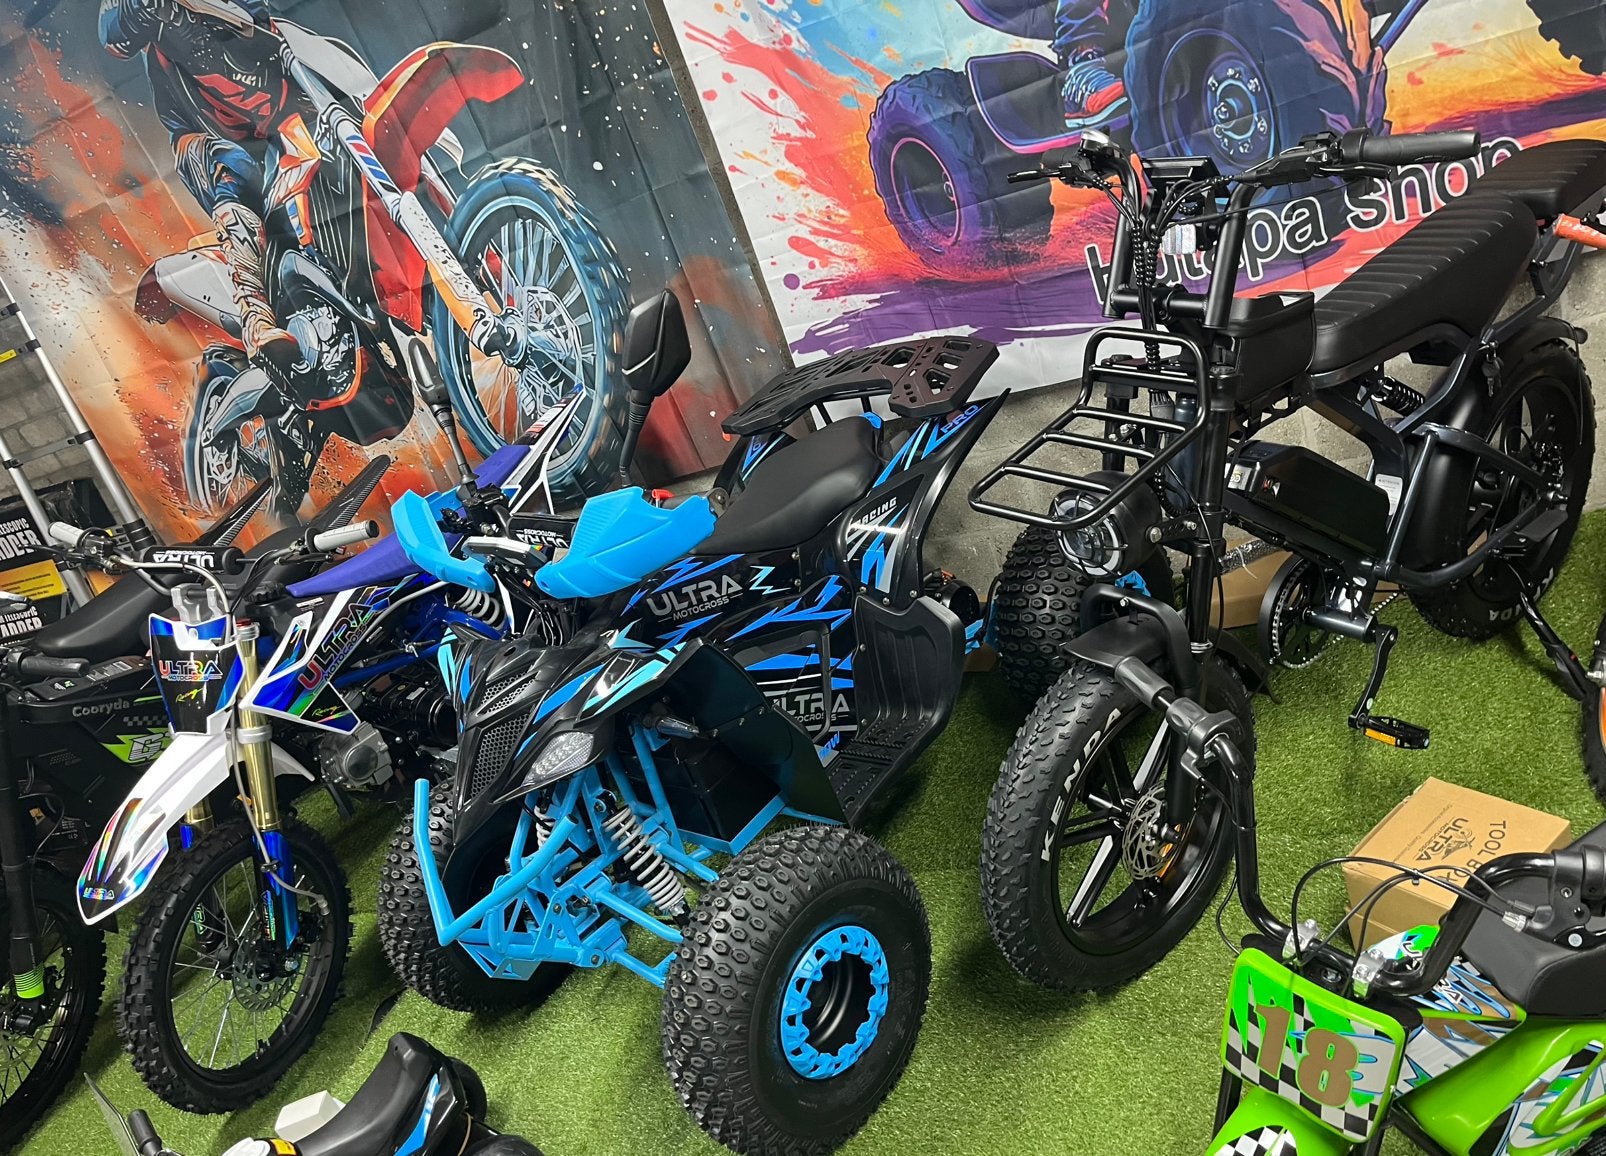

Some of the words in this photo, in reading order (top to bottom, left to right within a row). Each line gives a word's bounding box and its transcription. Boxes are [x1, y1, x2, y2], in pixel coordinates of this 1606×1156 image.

[854, 497, 897, 526] ACING
[152, 553, 215, 568] ULTRA
[646, 574, 743, 616] ULTRA
[672, 595, 730, 621] MOTOCROSS
[297, 602, 374, 690] ULTRA
[321, 622, 368, 682] MOTOCROSS
[158, 659, 223, 676] ULTRA
[773, 692, 850, 717] LTRA
[1040, 706, 1122, 862] KENDA
[1414, 817, 1470, 862] ULTRA
[1476, 820, 1507, 857] TOOL
[1254, 1003, 1360, 1109] 18
